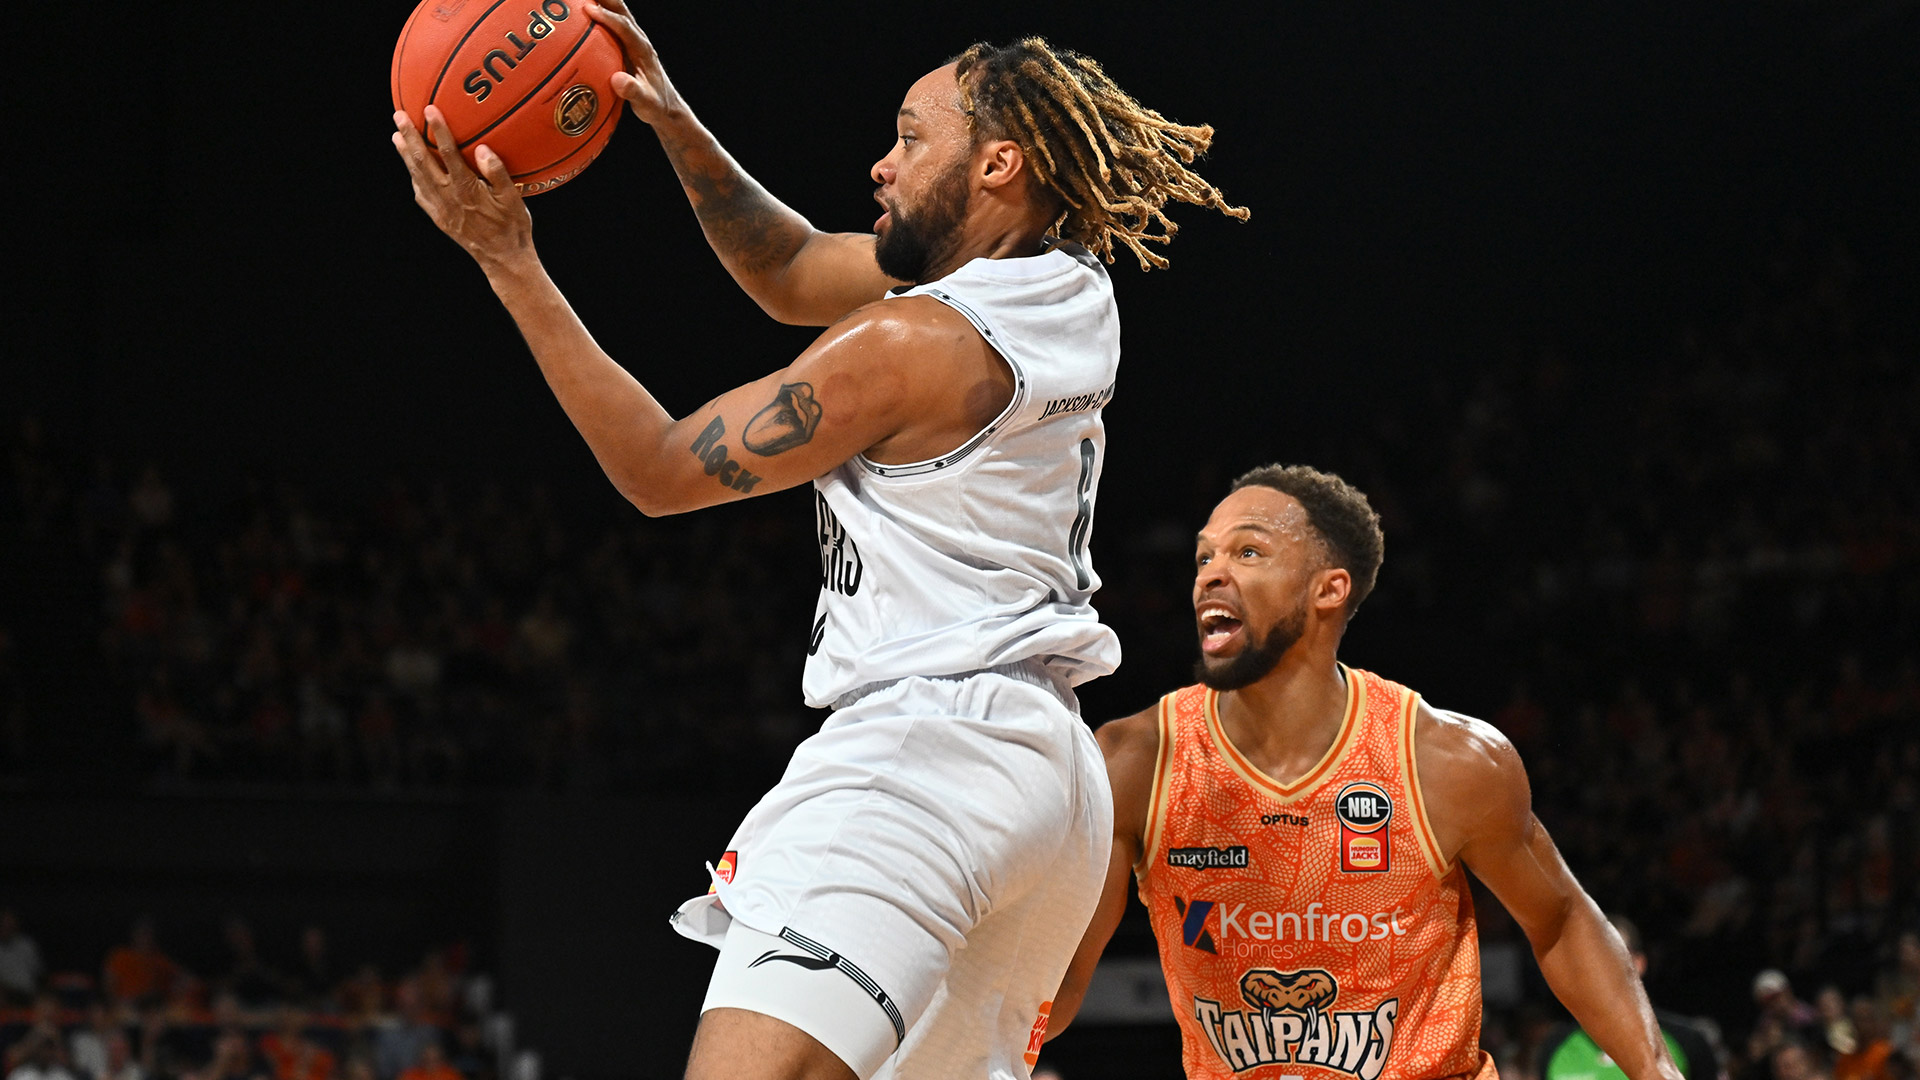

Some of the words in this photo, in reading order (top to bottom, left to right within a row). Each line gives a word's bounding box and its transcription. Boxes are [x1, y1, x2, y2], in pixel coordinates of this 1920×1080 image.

[463, 0, 570, 104] OPTUS
[690, 415, 763, 494] ROCK
[1068, 438, 1095, 590] 6
[1260, 814, 1310, 827] OPTUS
[1348, 797, 1380, 818] NBL
[1169, 849, 1247, 868] mayfield
[1219, 902, 1407, 943] Kenfrost
[1220, 938, 1294, 960] Homes
[1194, 996, 1399, 1080] TAIPANS
